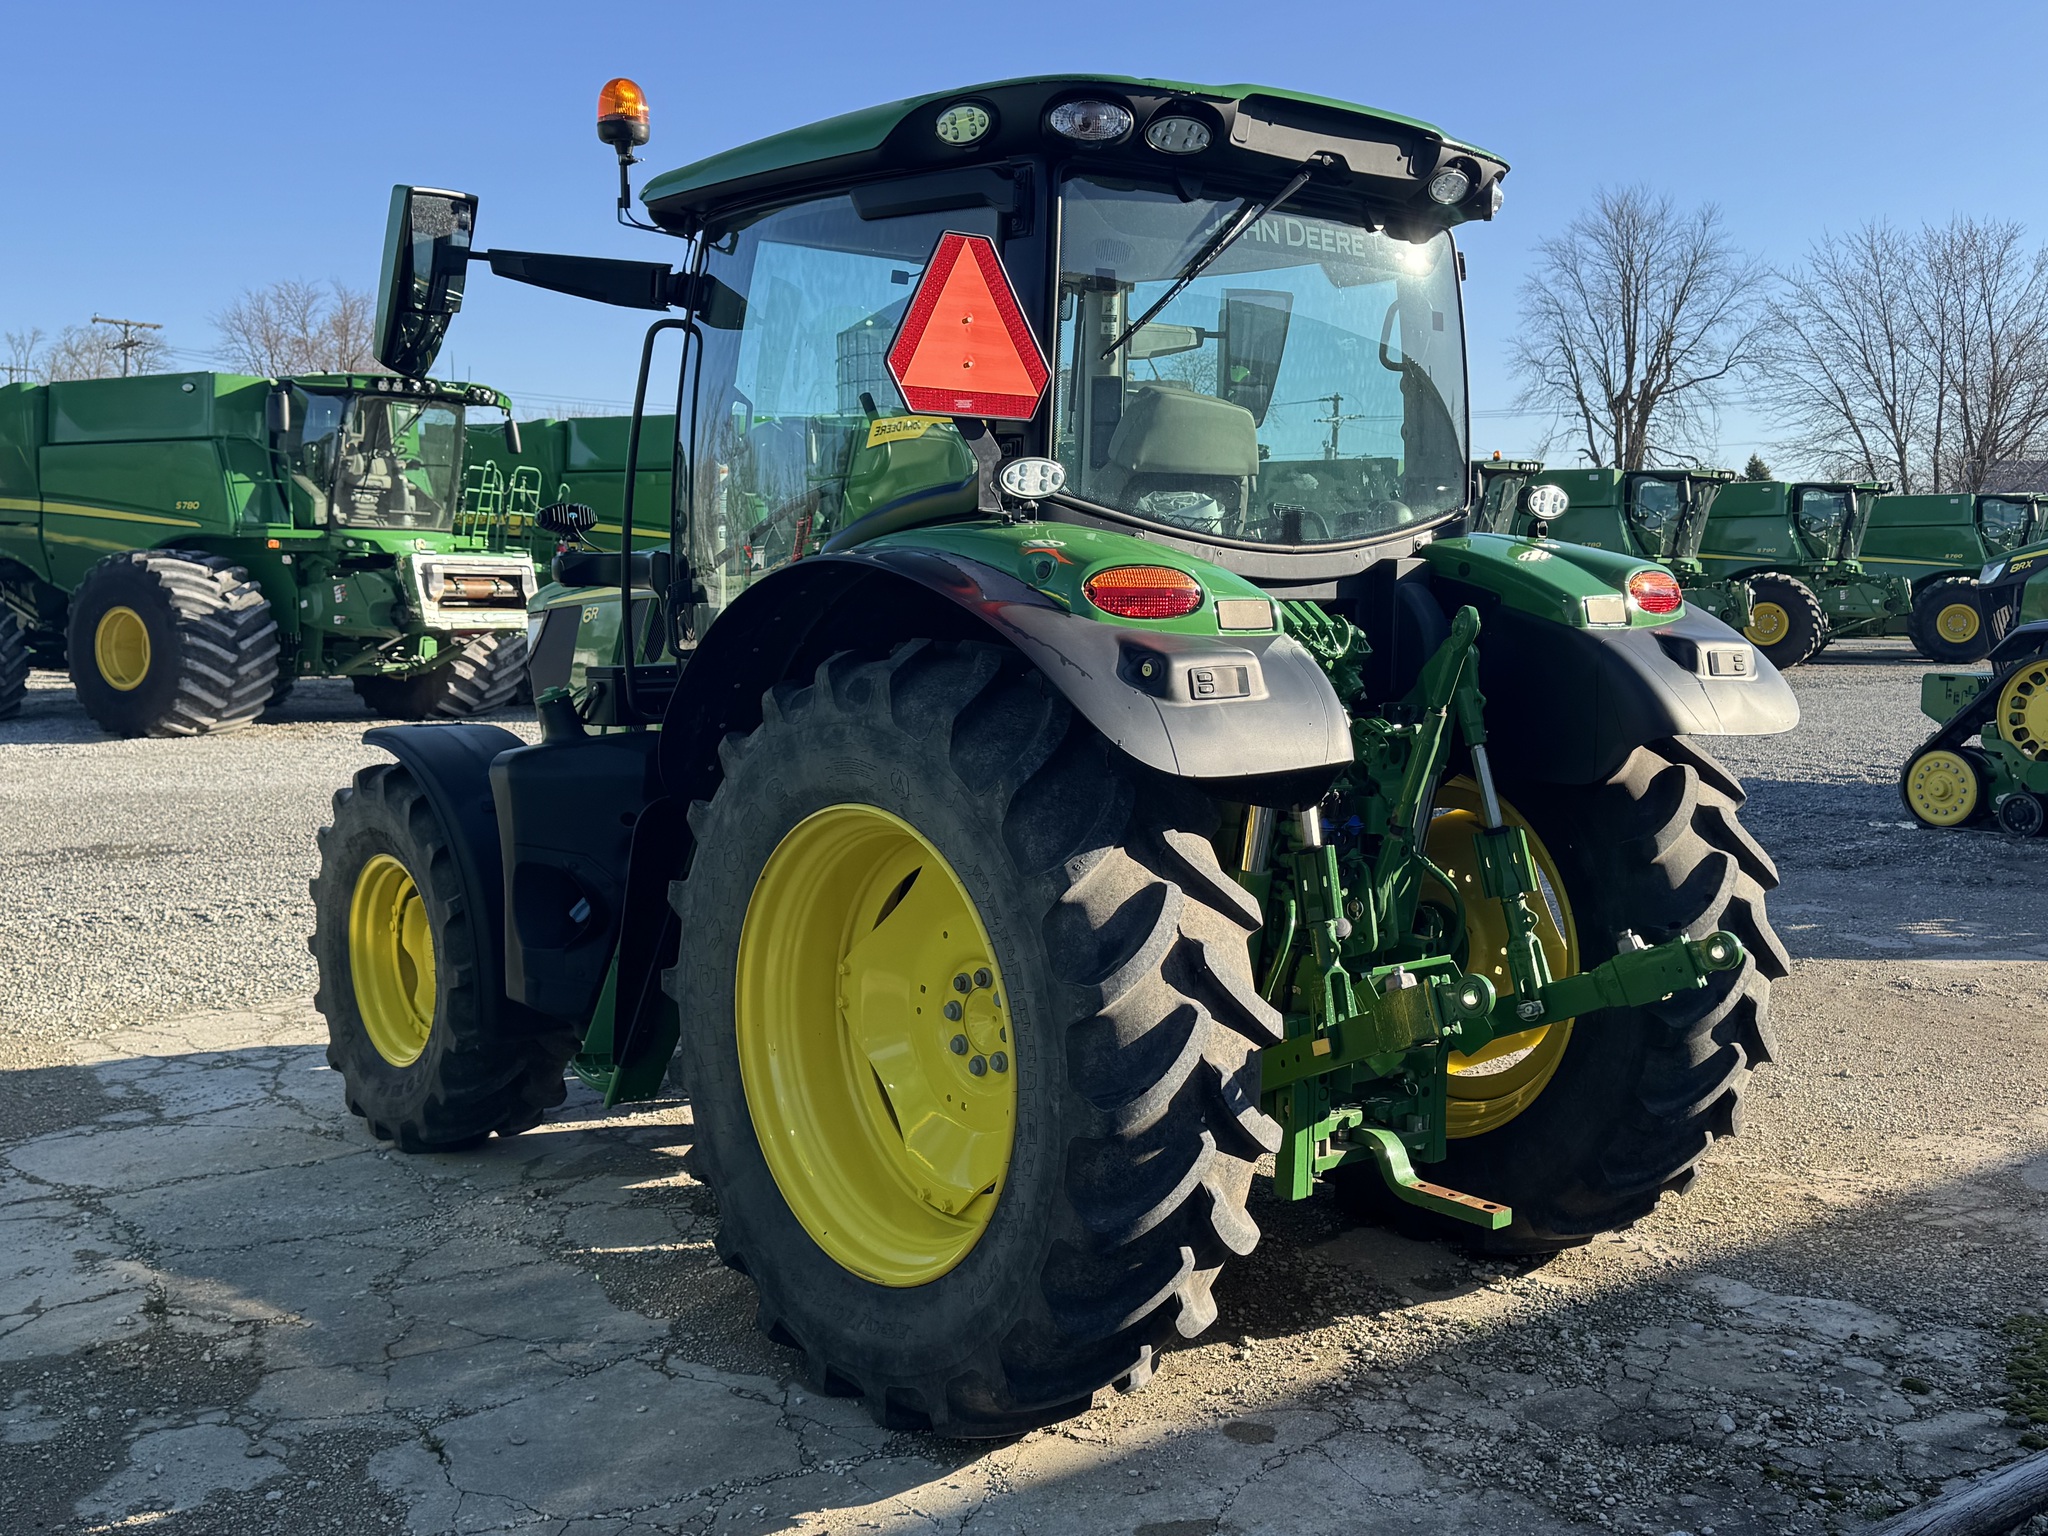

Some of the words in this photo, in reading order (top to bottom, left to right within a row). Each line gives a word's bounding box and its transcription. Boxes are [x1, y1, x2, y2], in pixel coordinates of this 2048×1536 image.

[1285, 217, 1366, 258] DEERE
[175, 501, 200, 510] S780
[2009, 560, 2034, 573] 8RX
[582, 606, 599, 624] 6R
